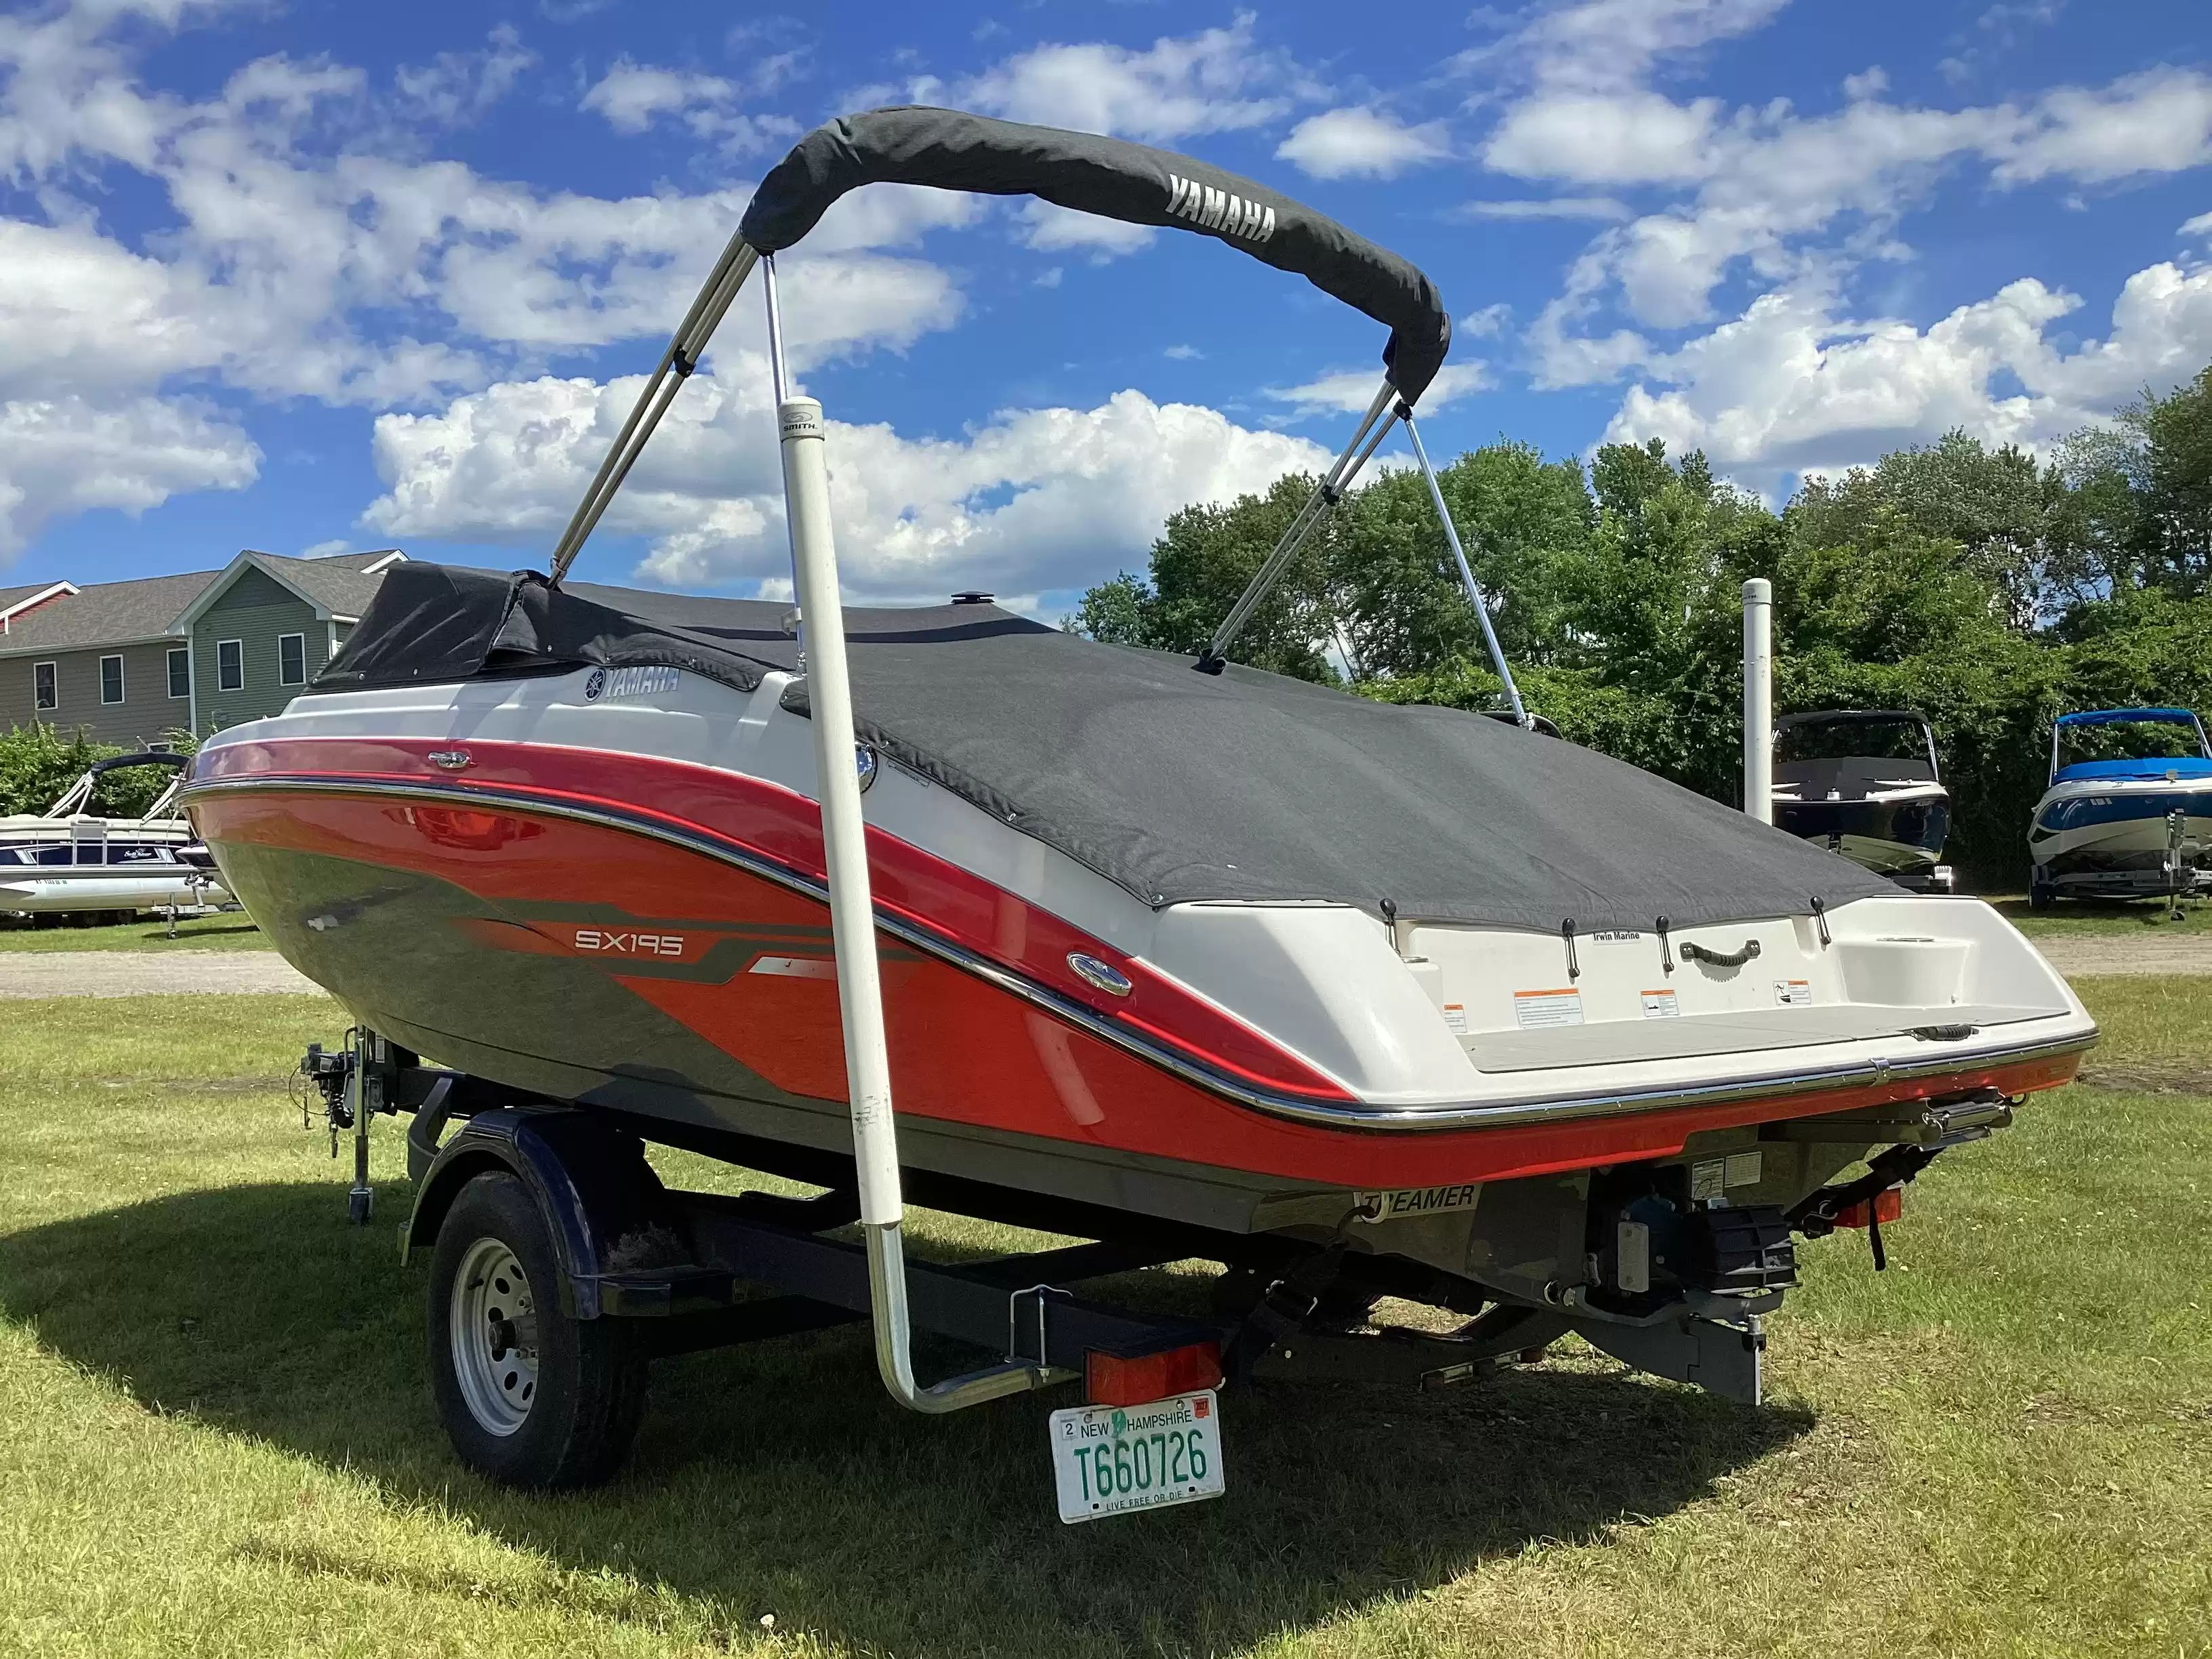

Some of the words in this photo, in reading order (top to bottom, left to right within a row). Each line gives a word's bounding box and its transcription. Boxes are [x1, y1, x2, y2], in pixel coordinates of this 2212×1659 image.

[1165, 173, 1275, 243] YAMAHA
[784, 423, 815, 431] SMITH
[605, 665, 680, 698] YAMAHA
[575, 930, 684, 956] SX195
[1593, 932, 1612, 941] Irwin
[1614, 930, 1640, 941] Marine
[1065, 1423, 1073, 1435] 2
[1080, 1422, 1109, 1438] NEW
[1126, 1410, 1192, 1431] HAMPSHIRE
[1073, 1429, 1207, 1501] T660726
[1106, 1500, 1125, 1511] LIVE
[1129, 1496, 1150, 1508] FREE
[1153, 1493, 1165, 1503] OR
[1169, 1490, 1183, 1501] DIE
